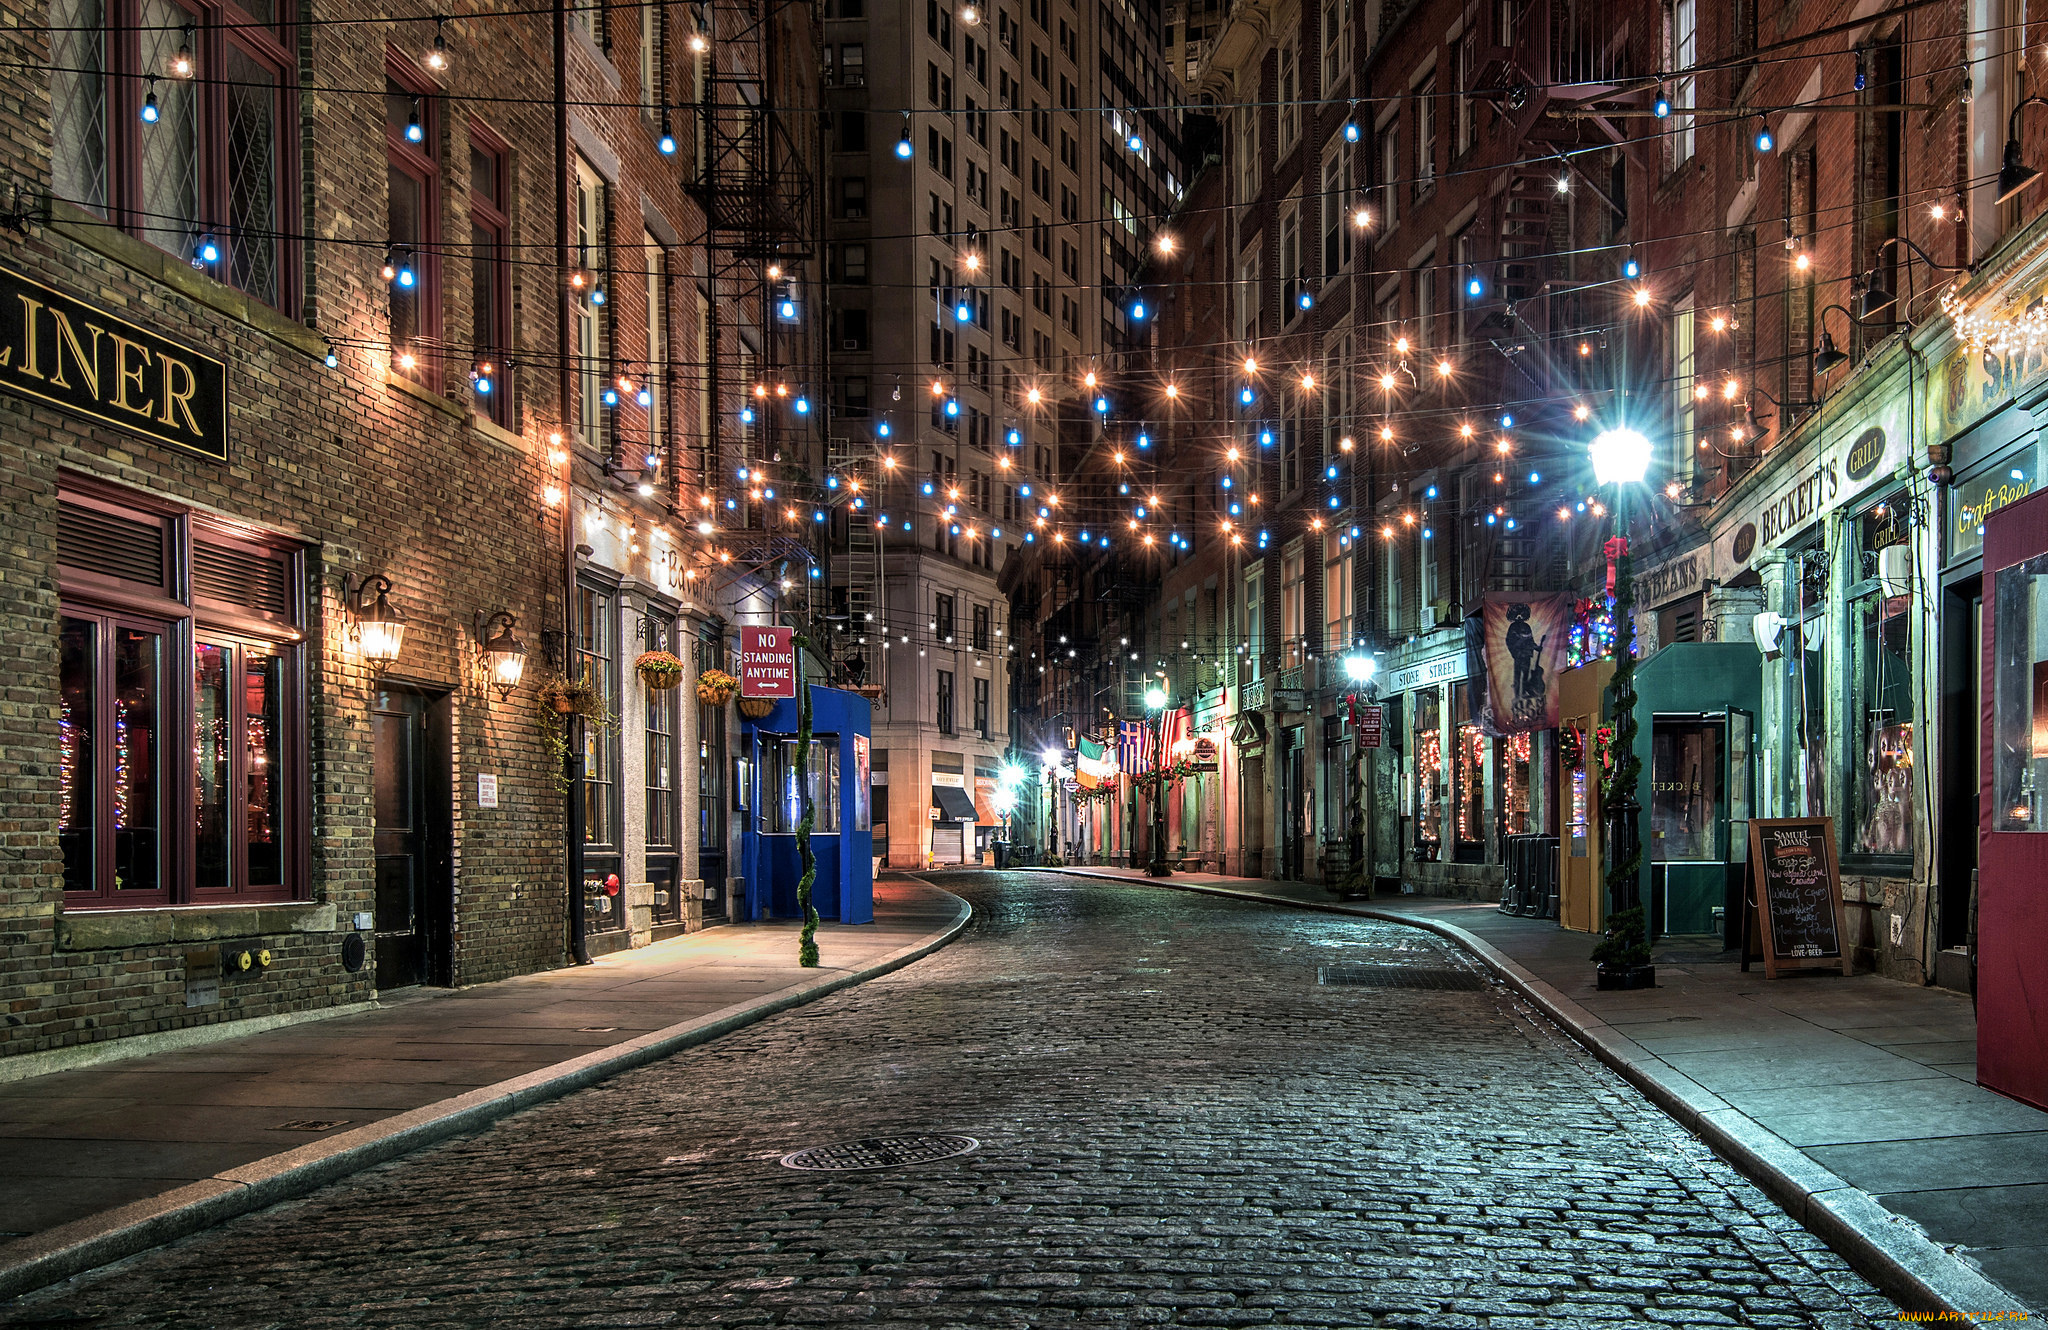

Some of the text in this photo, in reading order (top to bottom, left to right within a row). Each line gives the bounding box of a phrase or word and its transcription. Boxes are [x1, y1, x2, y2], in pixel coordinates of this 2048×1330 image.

[1851, 436, 1880, 474] GRILL
[1762, 456, 1838, 548] BECKETT'S
[1959, 477, 2034, 534] Craft Beer
[1737, 532, 1750, 556] BAR
[1874, 523, 1898, 550] GRILL
[668, 549, 714, 607] Bavaria
[1652, 555, 1697, 601] BEANS
[758, 633, 776, 648] NO
[743, 652, 792, 664] STANDING
[746, 667, 790, 679] ANYTIME
[1399, 660, 1457, 687] STONE STREET
[1774, 830, 1811, 841] SAMUEL
[1777, 838, 1809, 849] ADAMS
[1791, 949, 1805, 957] LOVE
[1809, 948, 1823, 956] BEER
